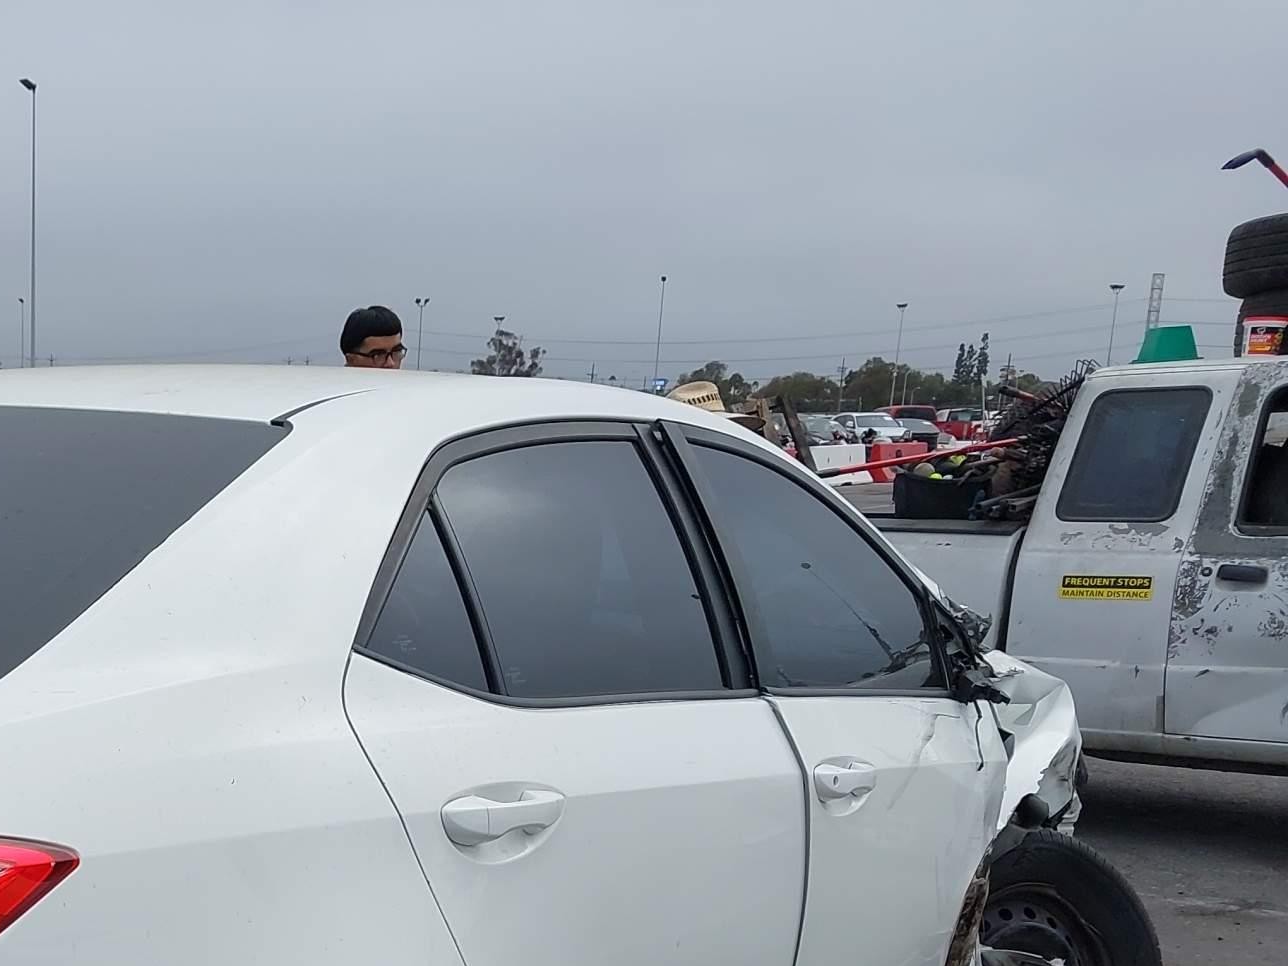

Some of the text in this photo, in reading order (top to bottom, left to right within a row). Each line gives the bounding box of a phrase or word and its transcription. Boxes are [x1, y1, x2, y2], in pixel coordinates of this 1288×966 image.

[1064, 577, 1150, 587] FREQUENT STOPS
[1061, 589, 1149, 598] MAINTAIN DISTANCE
